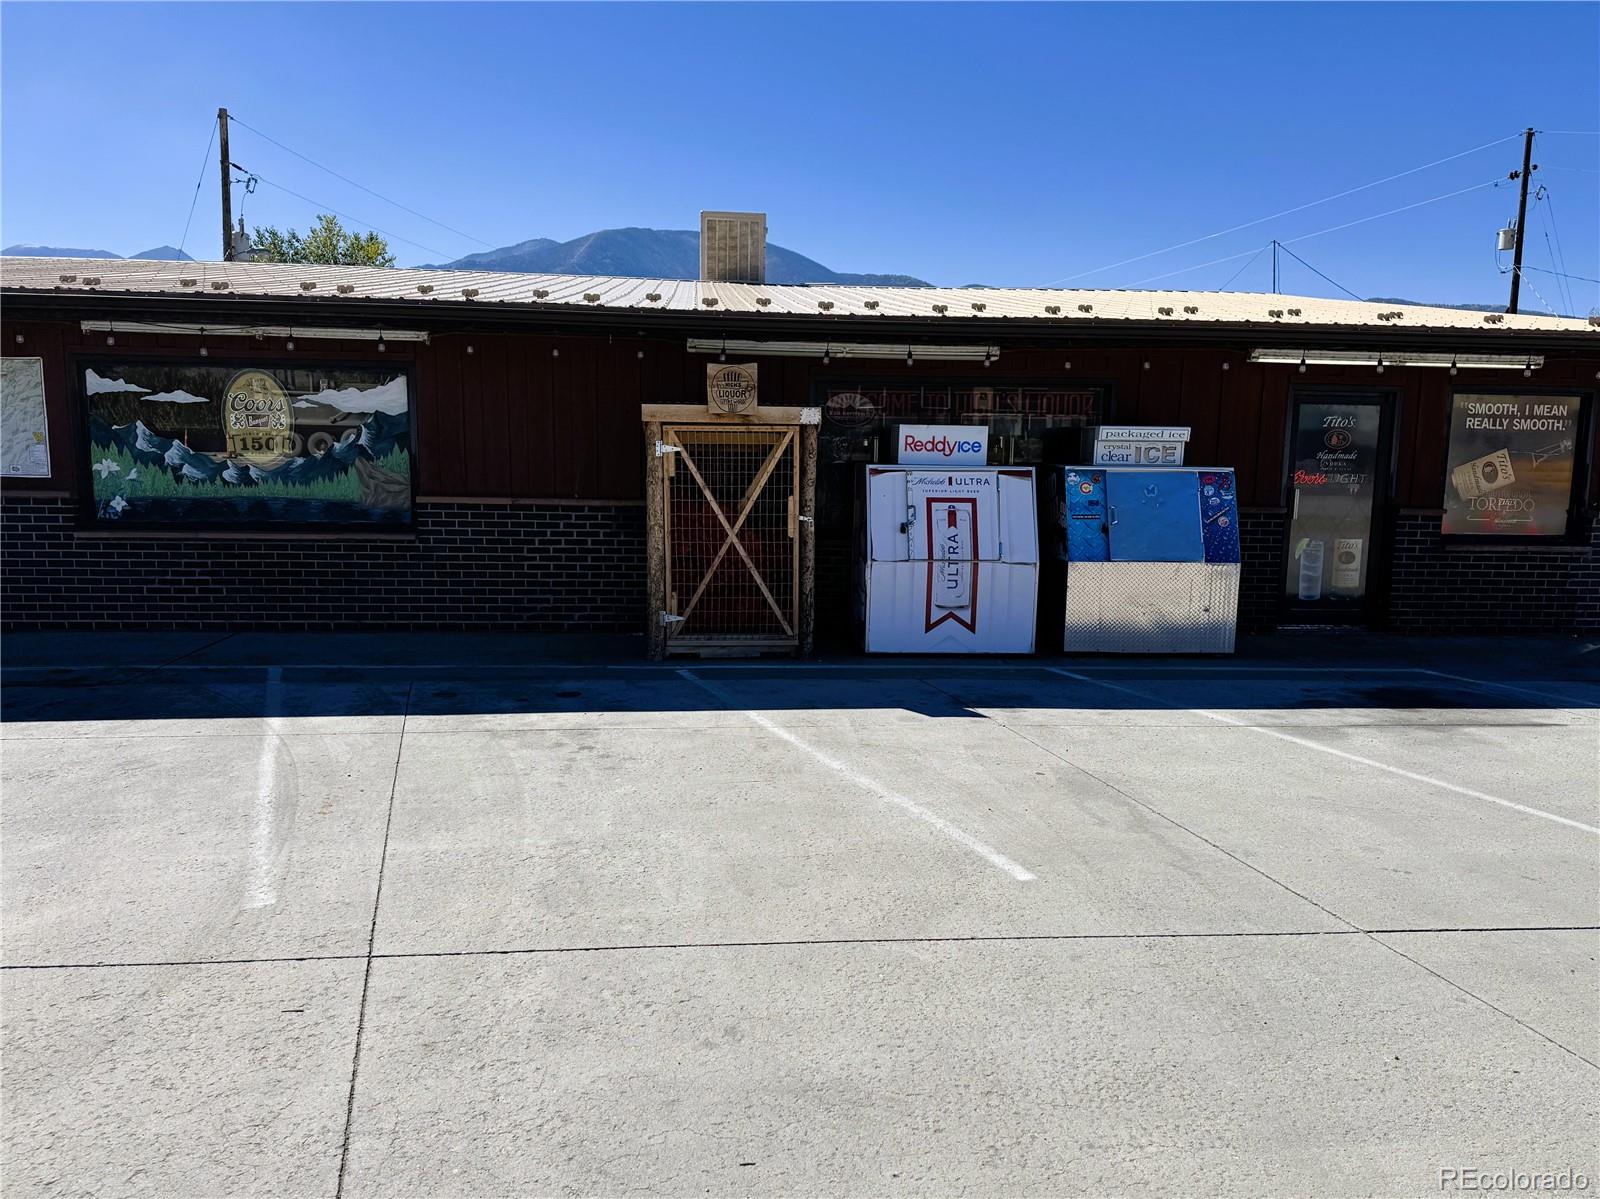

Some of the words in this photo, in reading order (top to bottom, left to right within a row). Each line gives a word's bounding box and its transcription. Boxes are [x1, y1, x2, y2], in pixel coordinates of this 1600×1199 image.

[718, 389, 747, 399] LIQUOR
[229, 392, 286, 412] Coors
[1525, 404, 1529, 416] I
[1533, 404, 1568, 417] MEAN
[1322, 416, 1356, 428] Tito's
[1465, 417, 1510, 430] REALLY
[1105, 430, 1164, 439] packaged
[1168, 431, 1186, 439] ice
[239, 436, 275, 451] 150
[1103, 444, 1132, 452] crystal
[1101, 451, 1132, 463] clear
[1134, 445, 1177, 464] ICE
[1315, 449, 1358, 461] Handmade
[955, 477, 991, 487] ULTRA
[946, 533, 959, 590] ULTRA
